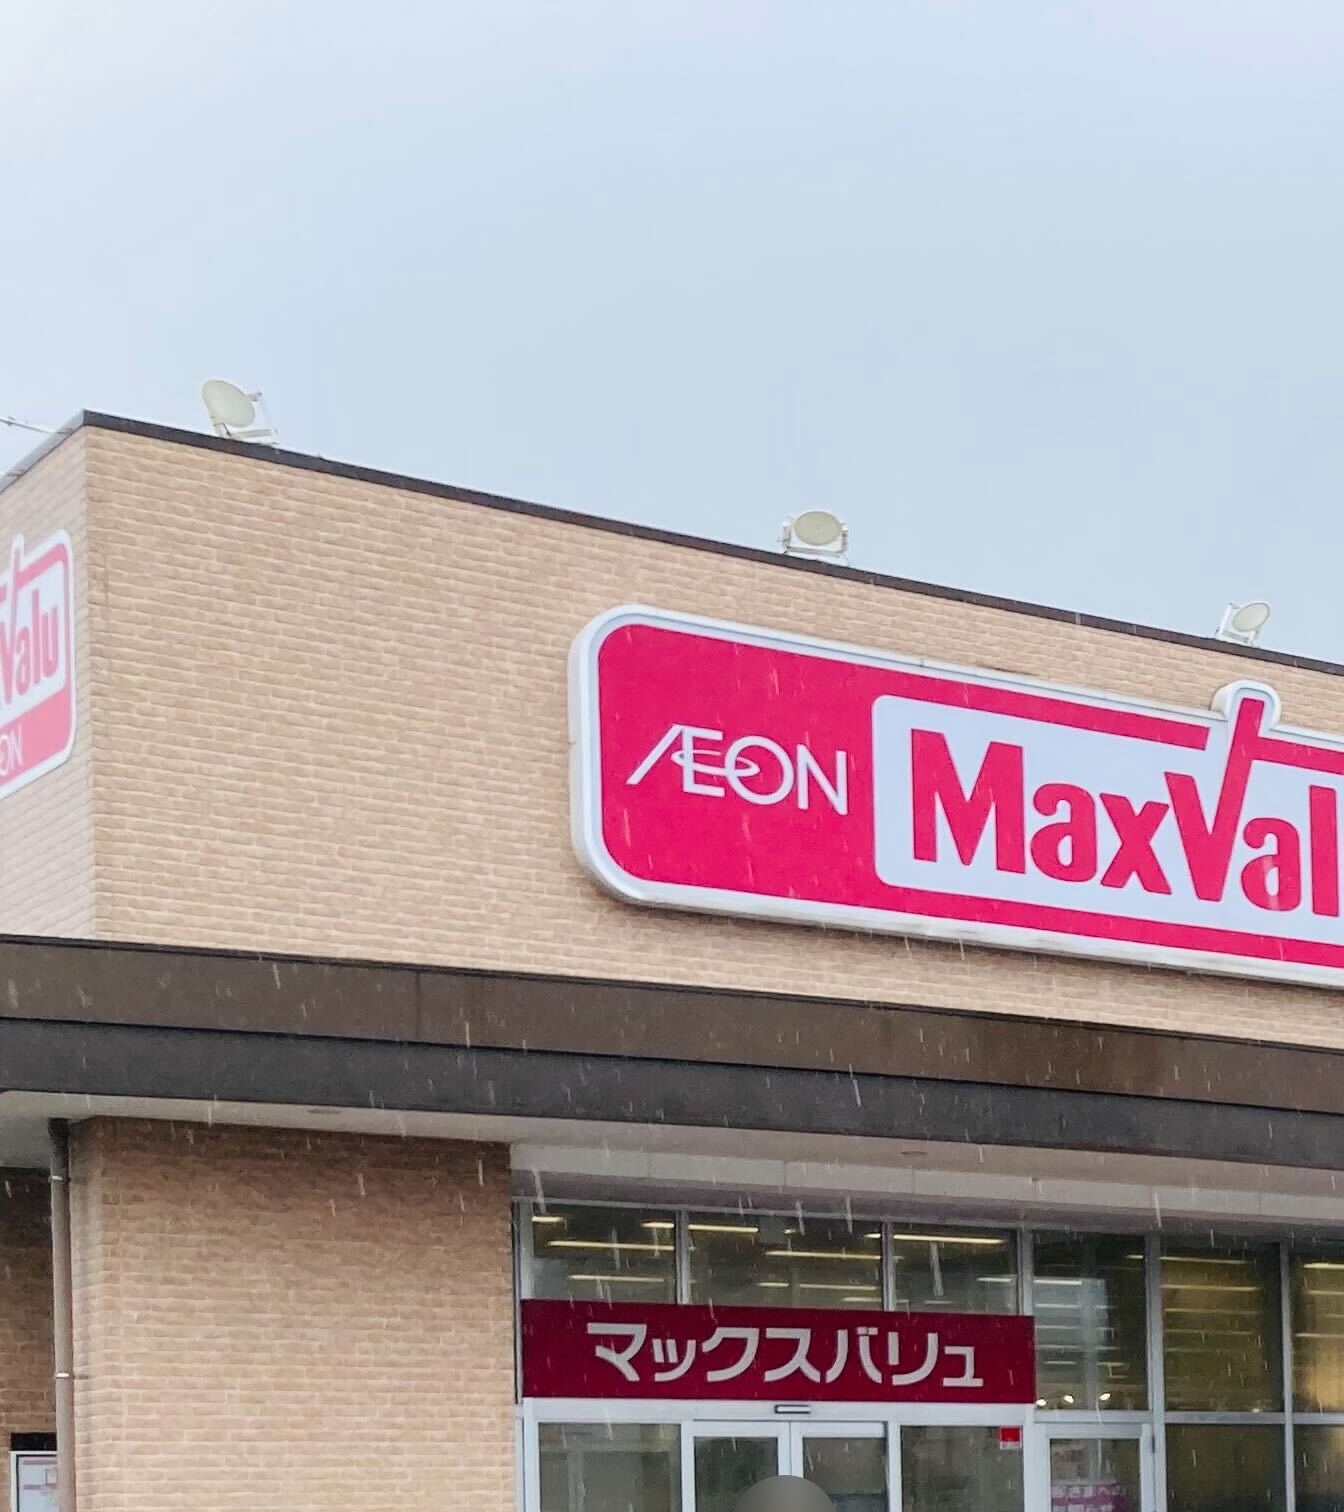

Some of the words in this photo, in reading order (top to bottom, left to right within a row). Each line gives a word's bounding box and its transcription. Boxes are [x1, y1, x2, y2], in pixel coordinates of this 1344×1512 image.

[586, 1321, 984, 1388] マックスバリュ
